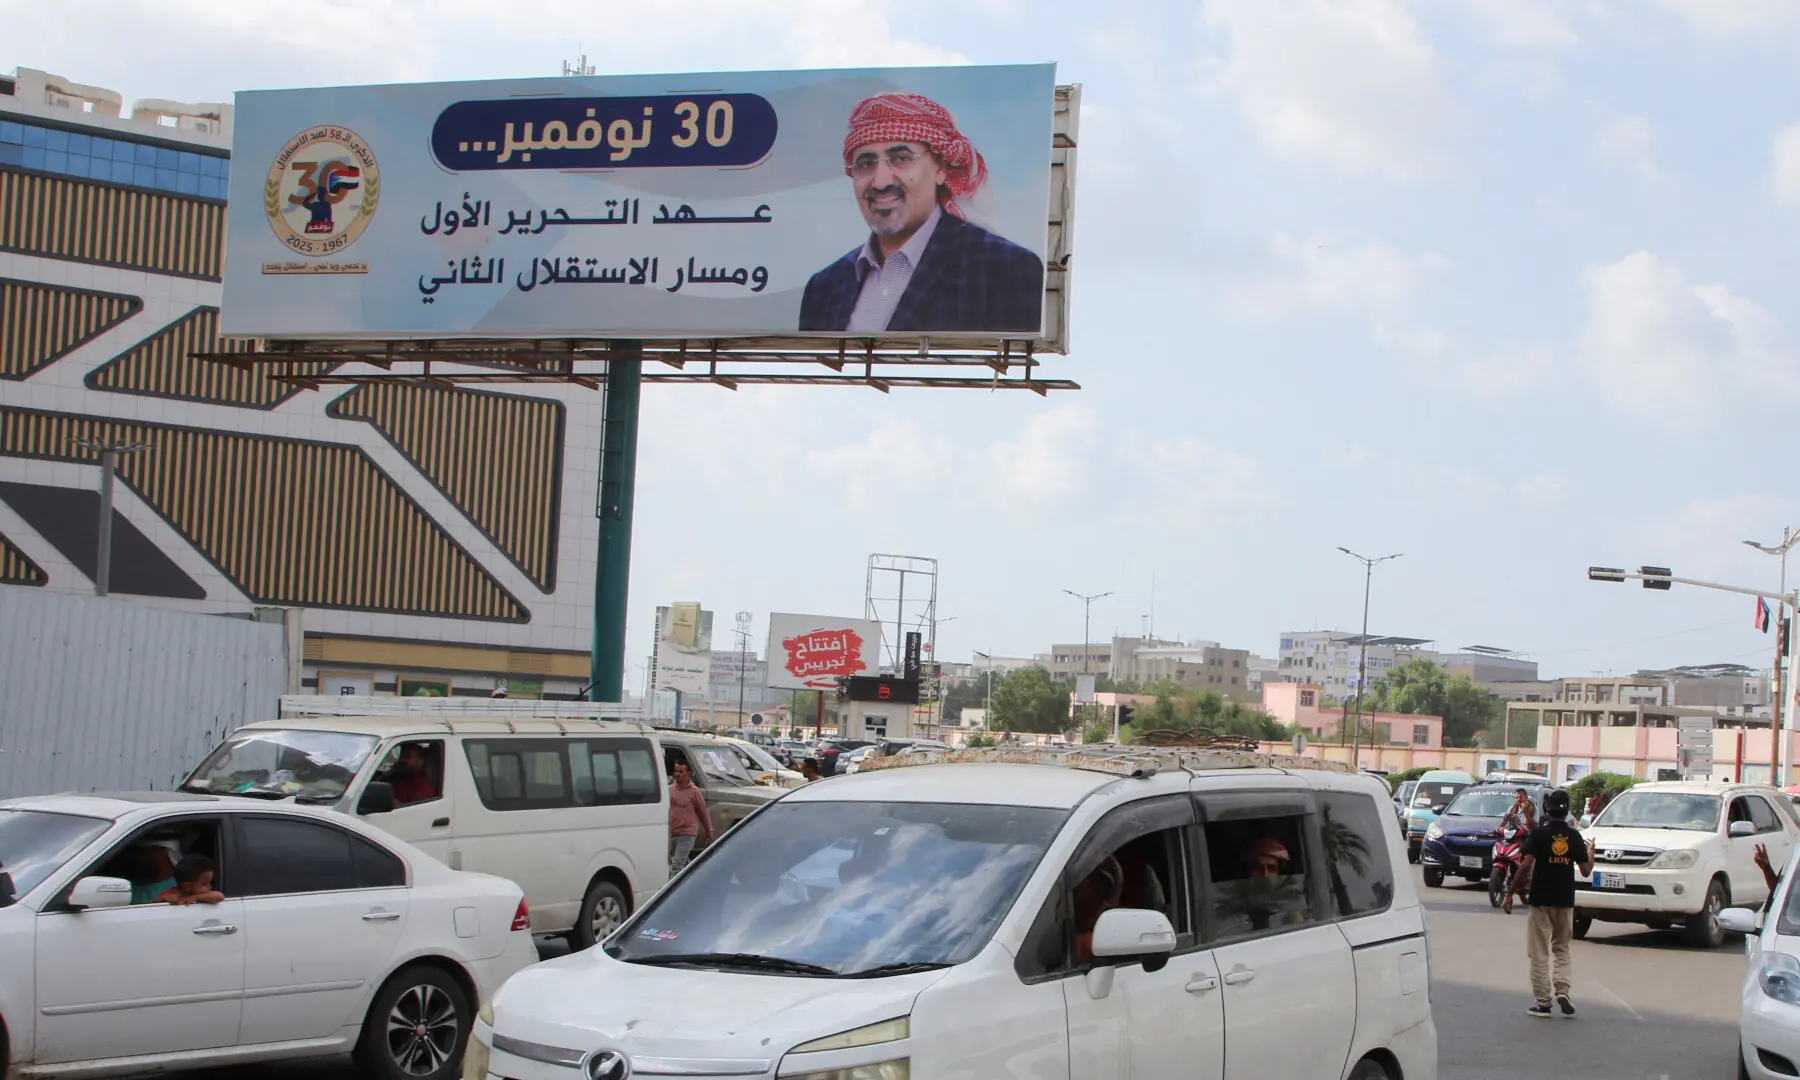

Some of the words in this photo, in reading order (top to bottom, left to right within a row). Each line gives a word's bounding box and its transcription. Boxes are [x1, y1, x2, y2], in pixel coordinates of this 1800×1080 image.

[329, 129, 341, 140] 58
[671, 100, 734, 147] 30
[420, 191, 491, 235] الأول
[307, 223, 332, 232] نوفمبر
[286, 234, 312, 252] 2025
[323, 234, 348, 252] 1967
[418, 254, 504, 304] الثاني
[517, 256, 658, 292] الاستقلال
[666, 256, 769, 292] ومسار
[796, 634, 848, 659] إفتتاح
[795, 656, 846, 675] تجريبي
[1549, 857, 1569, 865] LION
